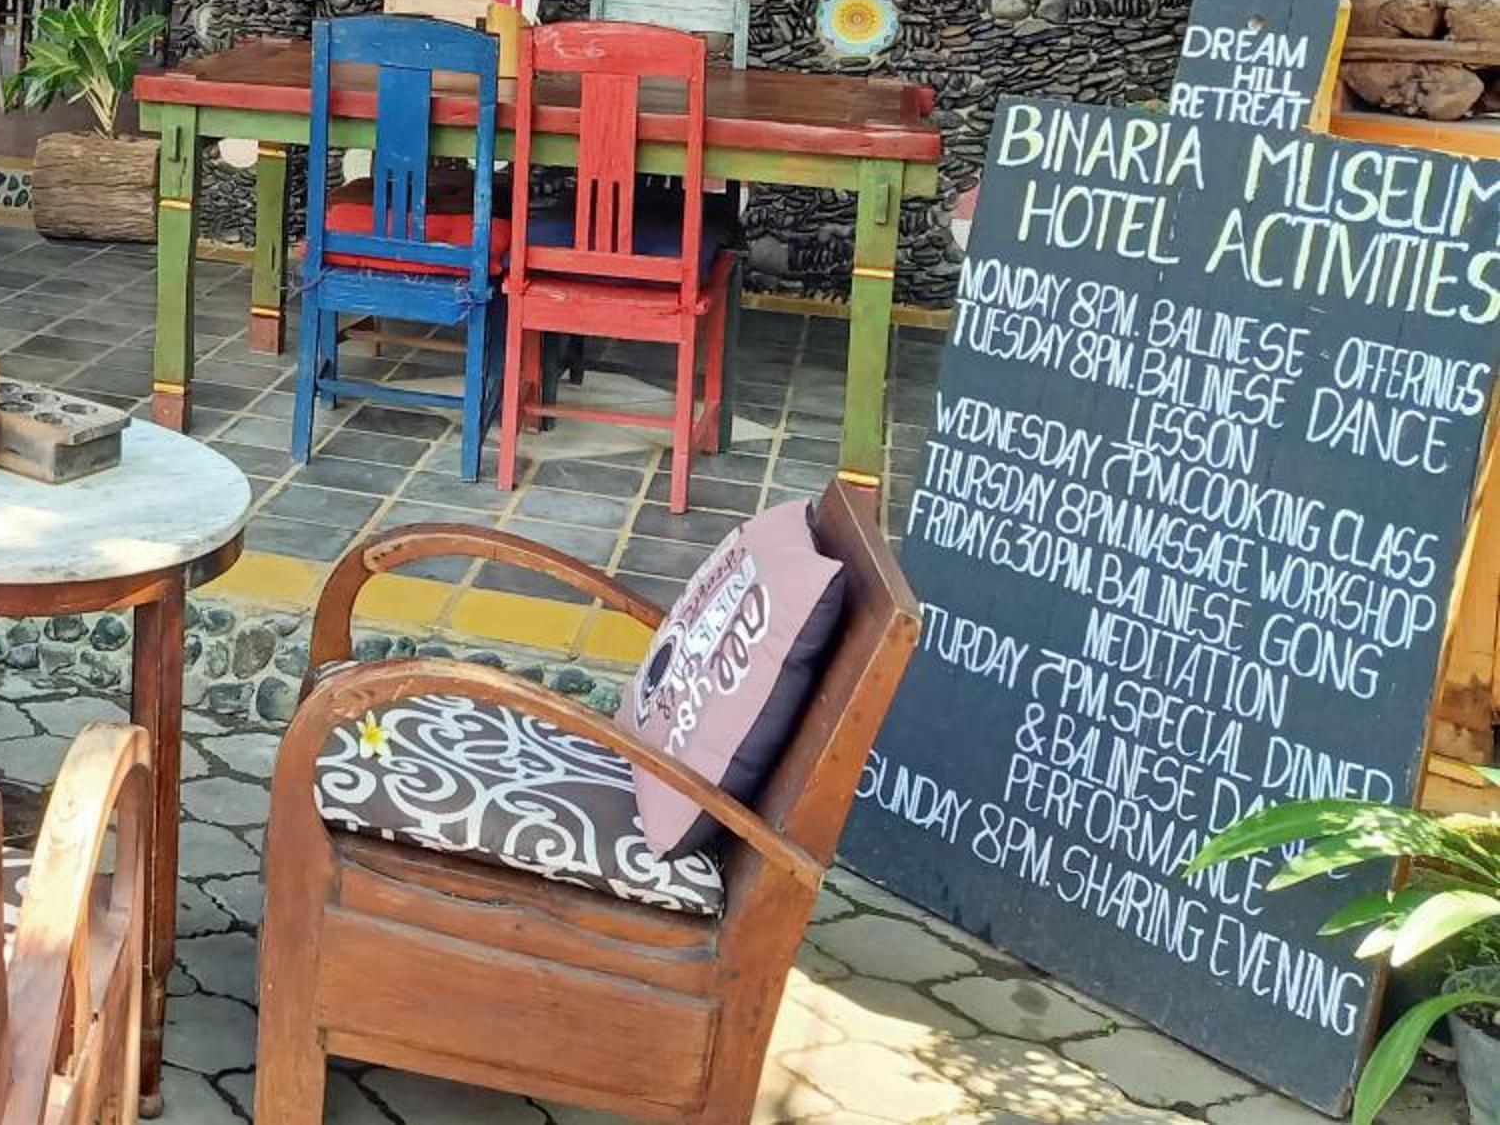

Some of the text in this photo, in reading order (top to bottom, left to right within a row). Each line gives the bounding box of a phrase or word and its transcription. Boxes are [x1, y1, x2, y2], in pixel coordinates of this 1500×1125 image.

[1169, 82, 1311, 131] RETREAT
[1182, 25, 1309, 69] DREAM
[1233, 64, 1302, 96] HILL
[997, 104, 1500, 246] BINARIA MUSEUM
[1018, 180, 1500, 324] HOTEL ACTIVITIES
[953, 298, 1075, 369] TUESDAY
[1137, 348, 1295, 428] BALINESE
[1306, 387, 1452, 473] DANCE
[957, 256, 1072, 319] MONDAY
[1148, 299, 1311, 376] BALINESE
[1334, 337, 1491, 416] OFFERINGS
[937, 391, 1103, 479] WEDNESDAY
[1180, 467, 1326, 551] COOKING
[1329, 509, 1439, 587] CLASS
[1128, 397, 1258, 475] LESSON
[907, 489, 996, 559] FRIDAY
[1096, 553, 1253, 651] BALINESE
[1259, 614, 1383, 699] GONG
[926, 441, 1057, 523] THURSDAY
[1128, 504, 1255, 593] MASSAGE
[1260, 545, 1436, 649] WORKSHOP
[915, 602, 1030, 689] TURDAY
[1110, 680, 1252, 781] SPECIAL
[1083, 607, 1289, 729] MEDITATION
[1015, 703, 1204, 821] & BALINESE
[1057, 845, 1207, 963] SHARING
[1210, 916, 1365, 1037] EVENING
